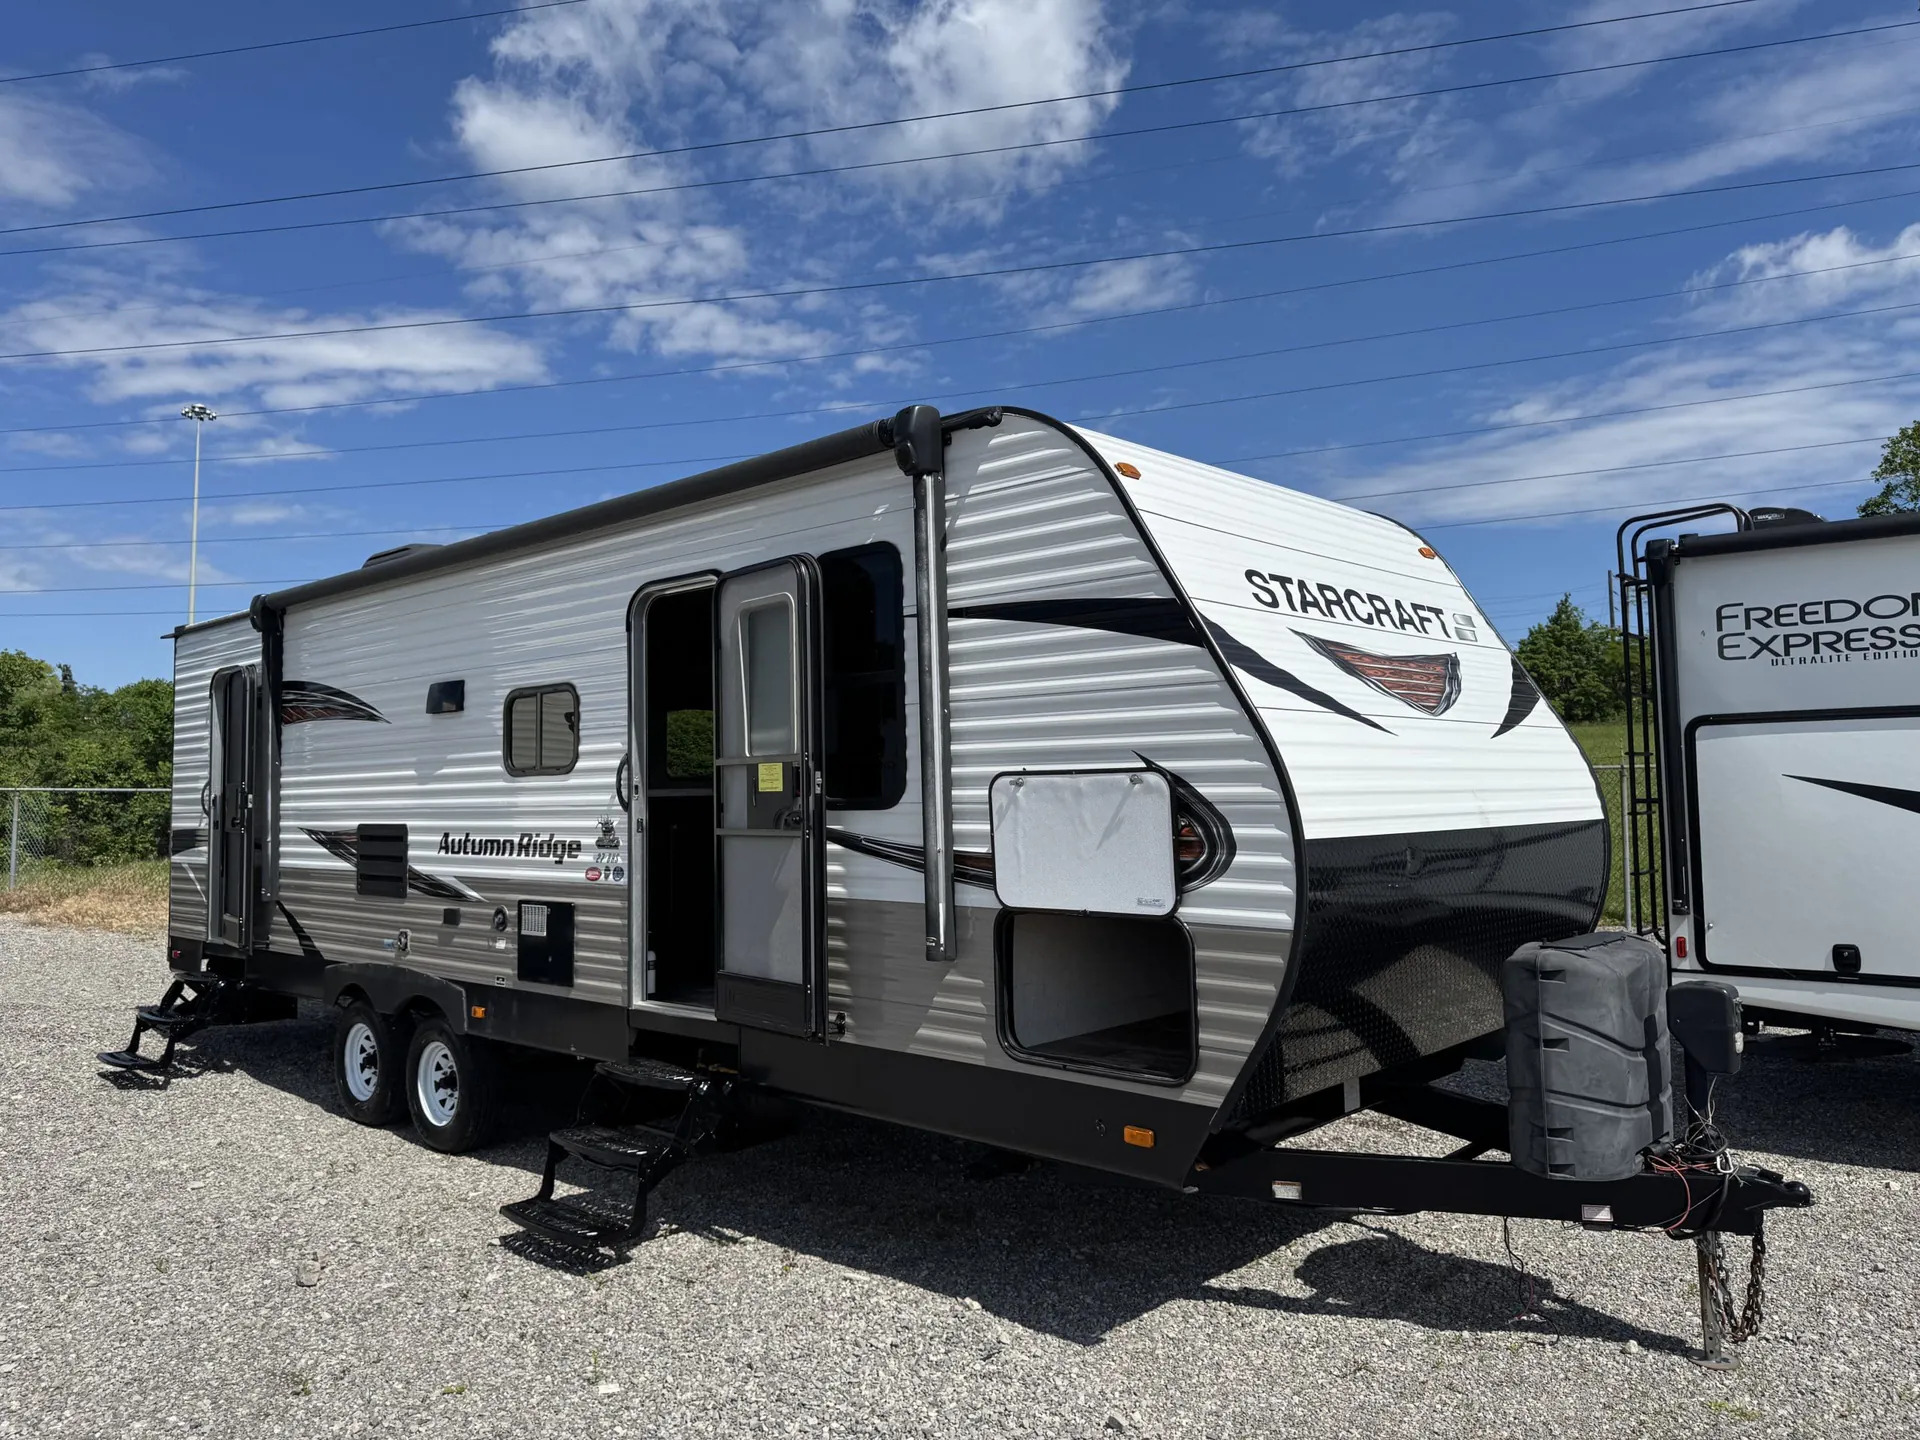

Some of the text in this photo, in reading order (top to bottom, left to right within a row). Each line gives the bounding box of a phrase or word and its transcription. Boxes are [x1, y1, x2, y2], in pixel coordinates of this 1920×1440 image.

[1244, 568, 1451, 639] STARCRAFT
[1717, 624, 1920, 661] EXPRESS
[1771, 653, 1852, 667] ULTRALITE
[438, 832, 515, 856] Autumn
[516, 833, 581, 864] Ridge
